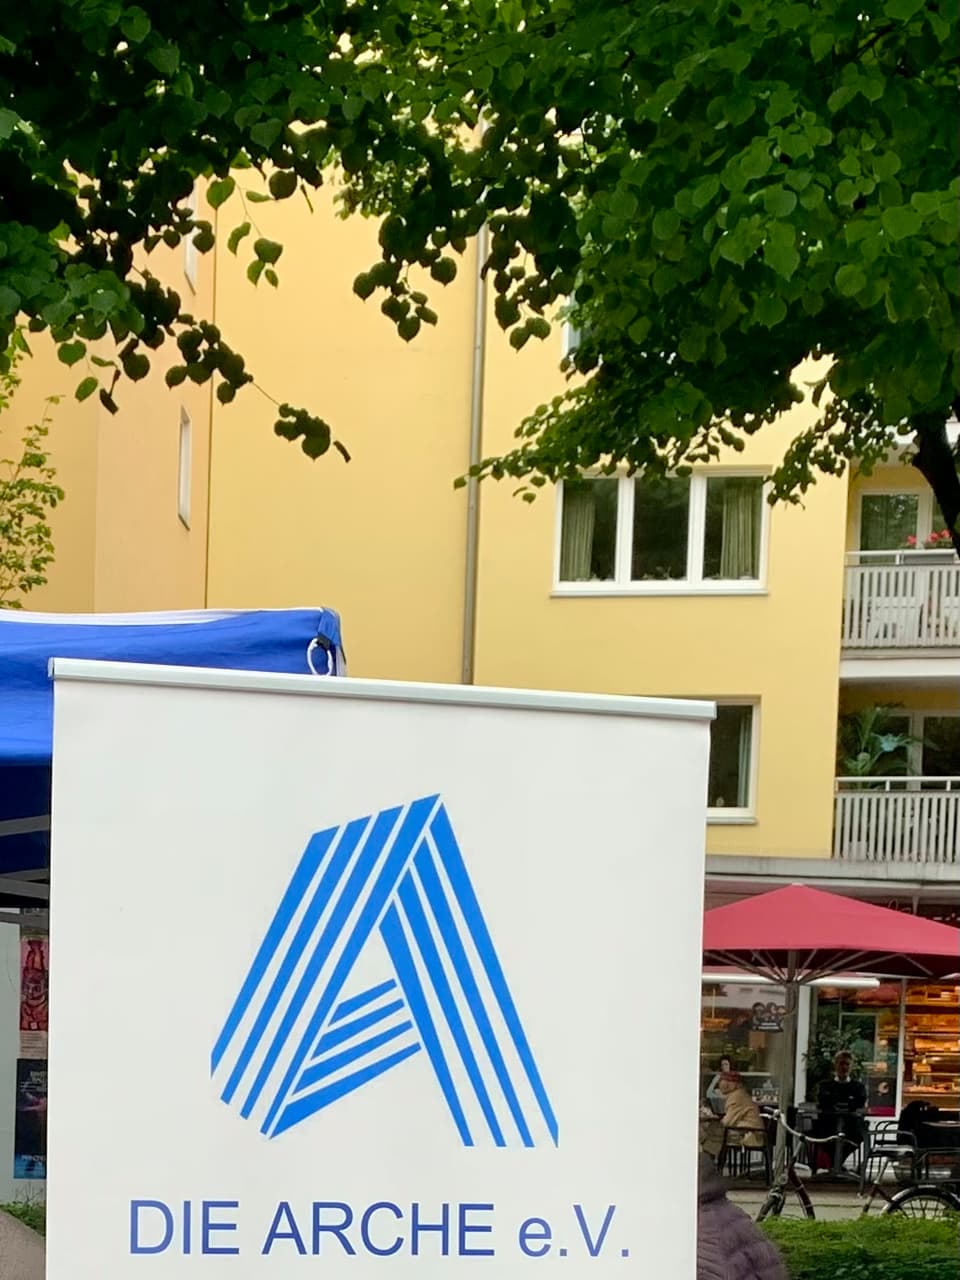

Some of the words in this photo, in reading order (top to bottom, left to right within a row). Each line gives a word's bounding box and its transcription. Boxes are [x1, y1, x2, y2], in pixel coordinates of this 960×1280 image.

[129, 1199, 240, 1256] DIE
[260, 1200, 496, 1257] ARCHE
[518, 1204, 630, 1258] e.V.
